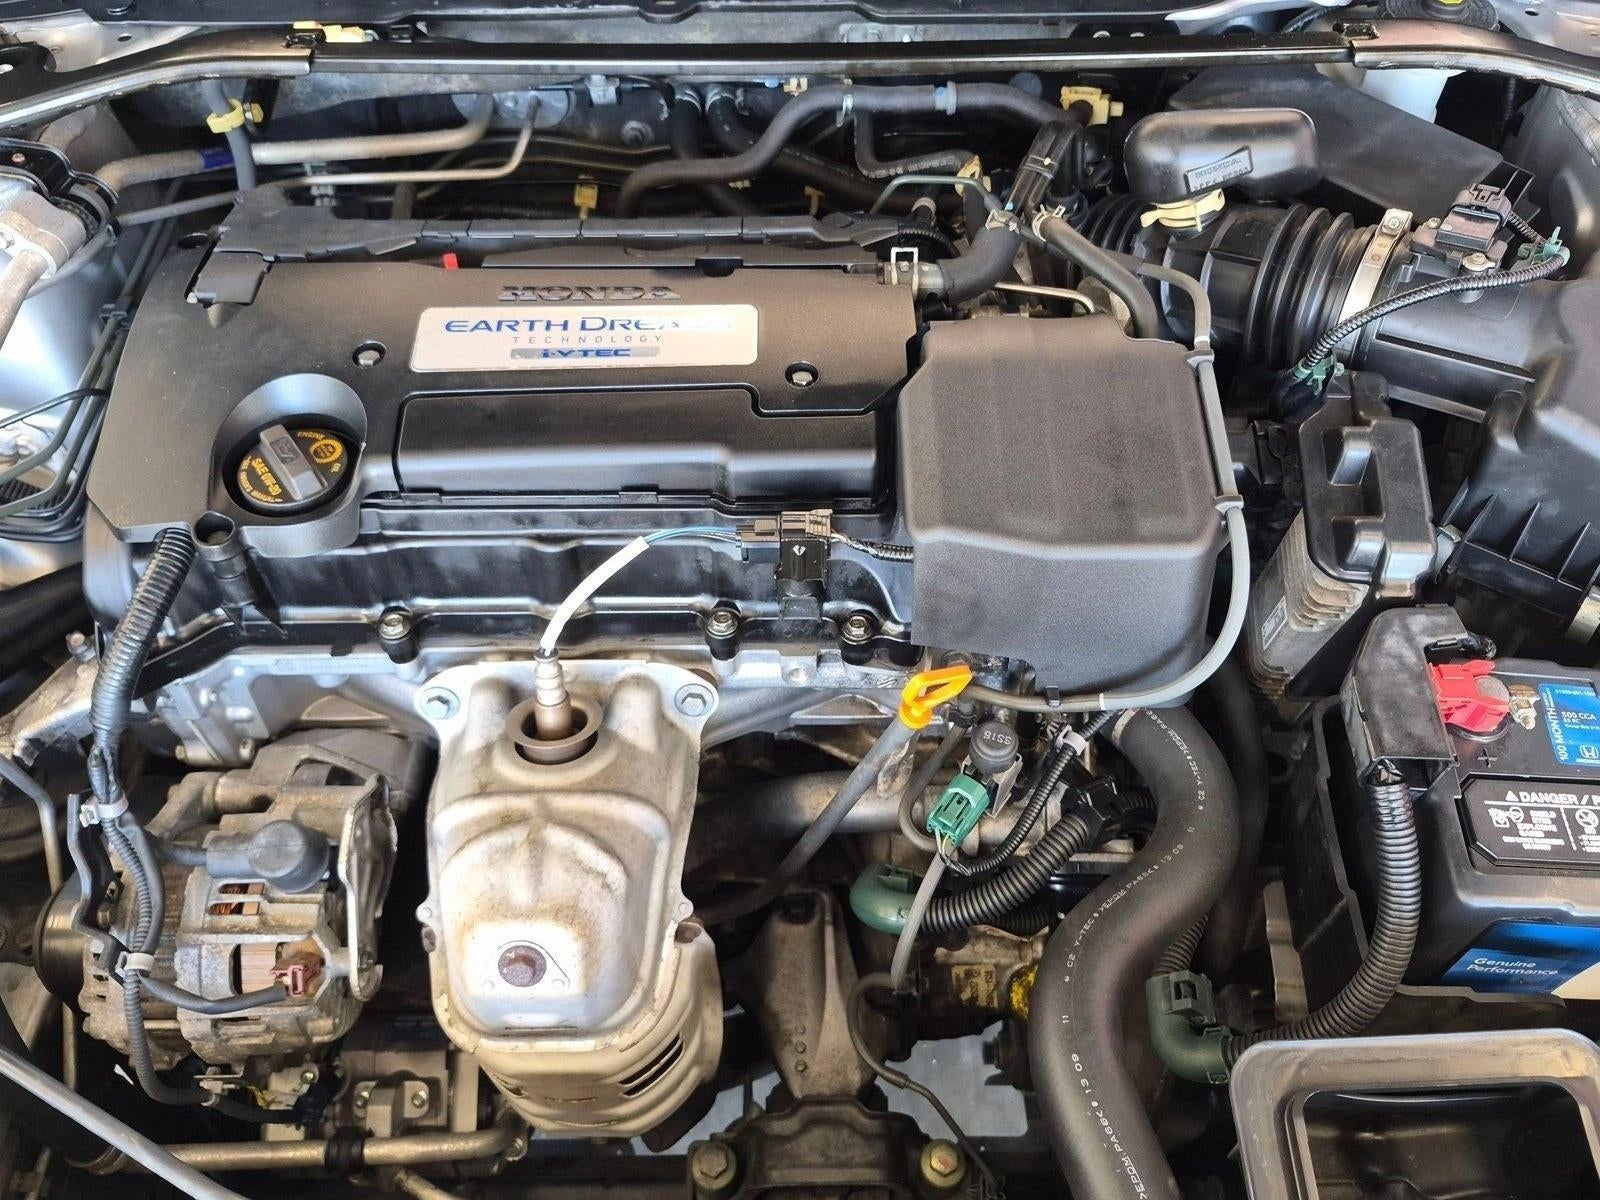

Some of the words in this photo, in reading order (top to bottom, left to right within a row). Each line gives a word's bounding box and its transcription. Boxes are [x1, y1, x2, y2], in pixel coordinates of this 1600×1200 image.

[497, 286, 681, 302] HONDA
[444, 318, 569, 333] EARTH
[513, 335, 664, 344] TECHNOLOGY
[251, 457, 268, 477] SAE
[1561, 711, 1577, 719] 500
[1578, 712, 1597, 720] CCA
[1546, 707, 1566, 745] MONTH
[983, 730, 1012, 745] SS15
[1556, 745, 1570, 761] 100
[1520, 791, 1578, 806] DANGER
[1066, 953, 1076, 968] C2
[1474, 958, 1536, 968] Genuine
[1466, 964, 1559, 976] Performance
